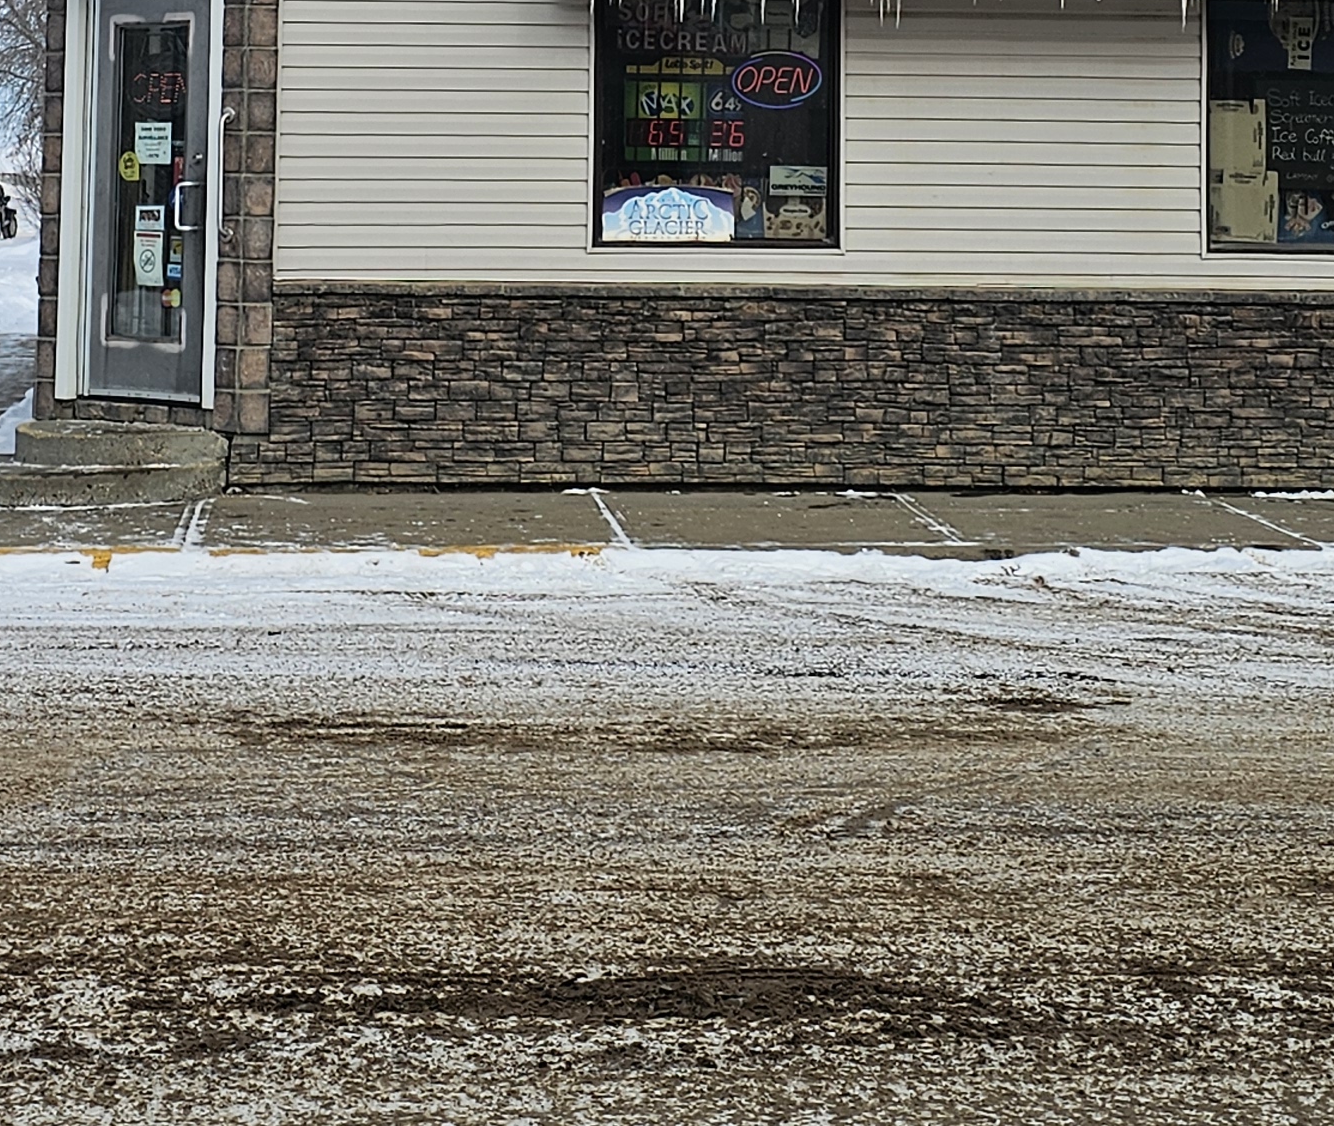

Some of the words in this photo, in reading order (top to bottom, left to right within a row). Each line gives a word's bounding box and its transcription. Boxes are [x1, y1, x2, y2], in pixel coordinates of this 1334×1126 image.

[1296, 25, 1312, 61] ICE
[664, 58, 688, 69] Loto
[689, 59, 714, 70] Spt!
[737, 65, 814, 94] OPEN
[1267, 87, 1300, 108] Soft
[647, 120, 684, 146] 65
[1271, 126, 1298, 143] Ice
[1271, 145, 1296, 161] Red
[1302, 147, 1327, 163] bull
[628, 198, 709, 220] ARCTIC
[628, 220, 708, 235] GLACIER
